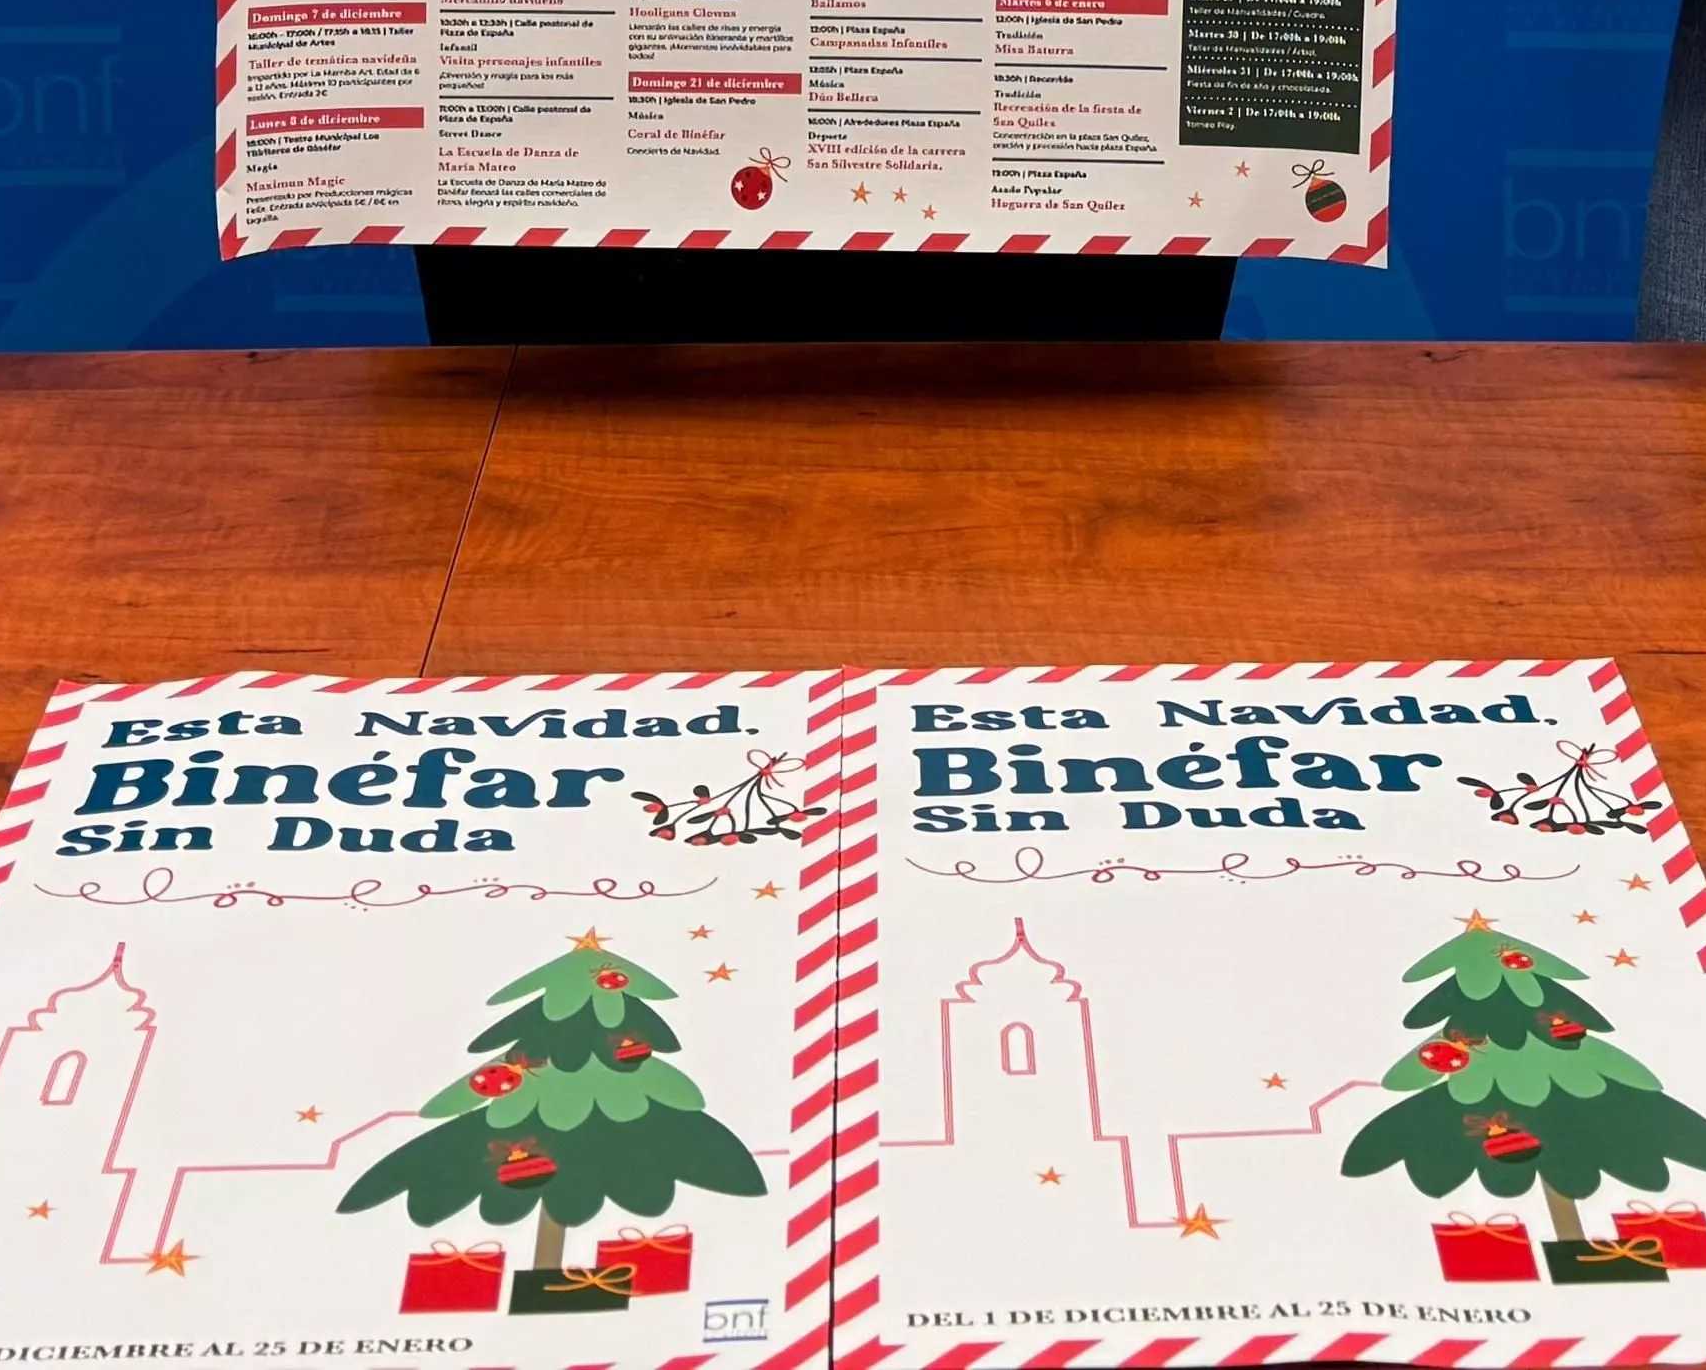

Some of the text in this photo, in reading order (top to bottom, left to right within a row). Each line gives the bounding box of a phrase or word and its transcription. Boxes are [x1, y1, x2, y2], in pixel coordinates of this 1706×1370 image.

[631, 76, 784, 90] Domingo 21 de diciembre
[249, 112, 380, 130] Lunes 8 de diciembre
[101, 705, 758, 747] Esta Navidad,
[911, 695, 1557, 731] Esta Navidad,
[74, 747, 624, 814] Binéfar
[912, 735, 1442, 798] Binéfar
[913, 797, 1365, 832] Sin Duda
[55, 819, 514, 855] Sin Duda
[704, 1304, 768, 1331] bnf
[907, 1300, 1531, 1327] DEL 1 DE DICIEMBRE AL 25 DE ENERO
[200, 1341, 243, 1356] AL
[253, 1341, 286, 1356] 25
[297, 1340, 344, 1355] DE
[354, 1337, 473, 1354] ENERO
